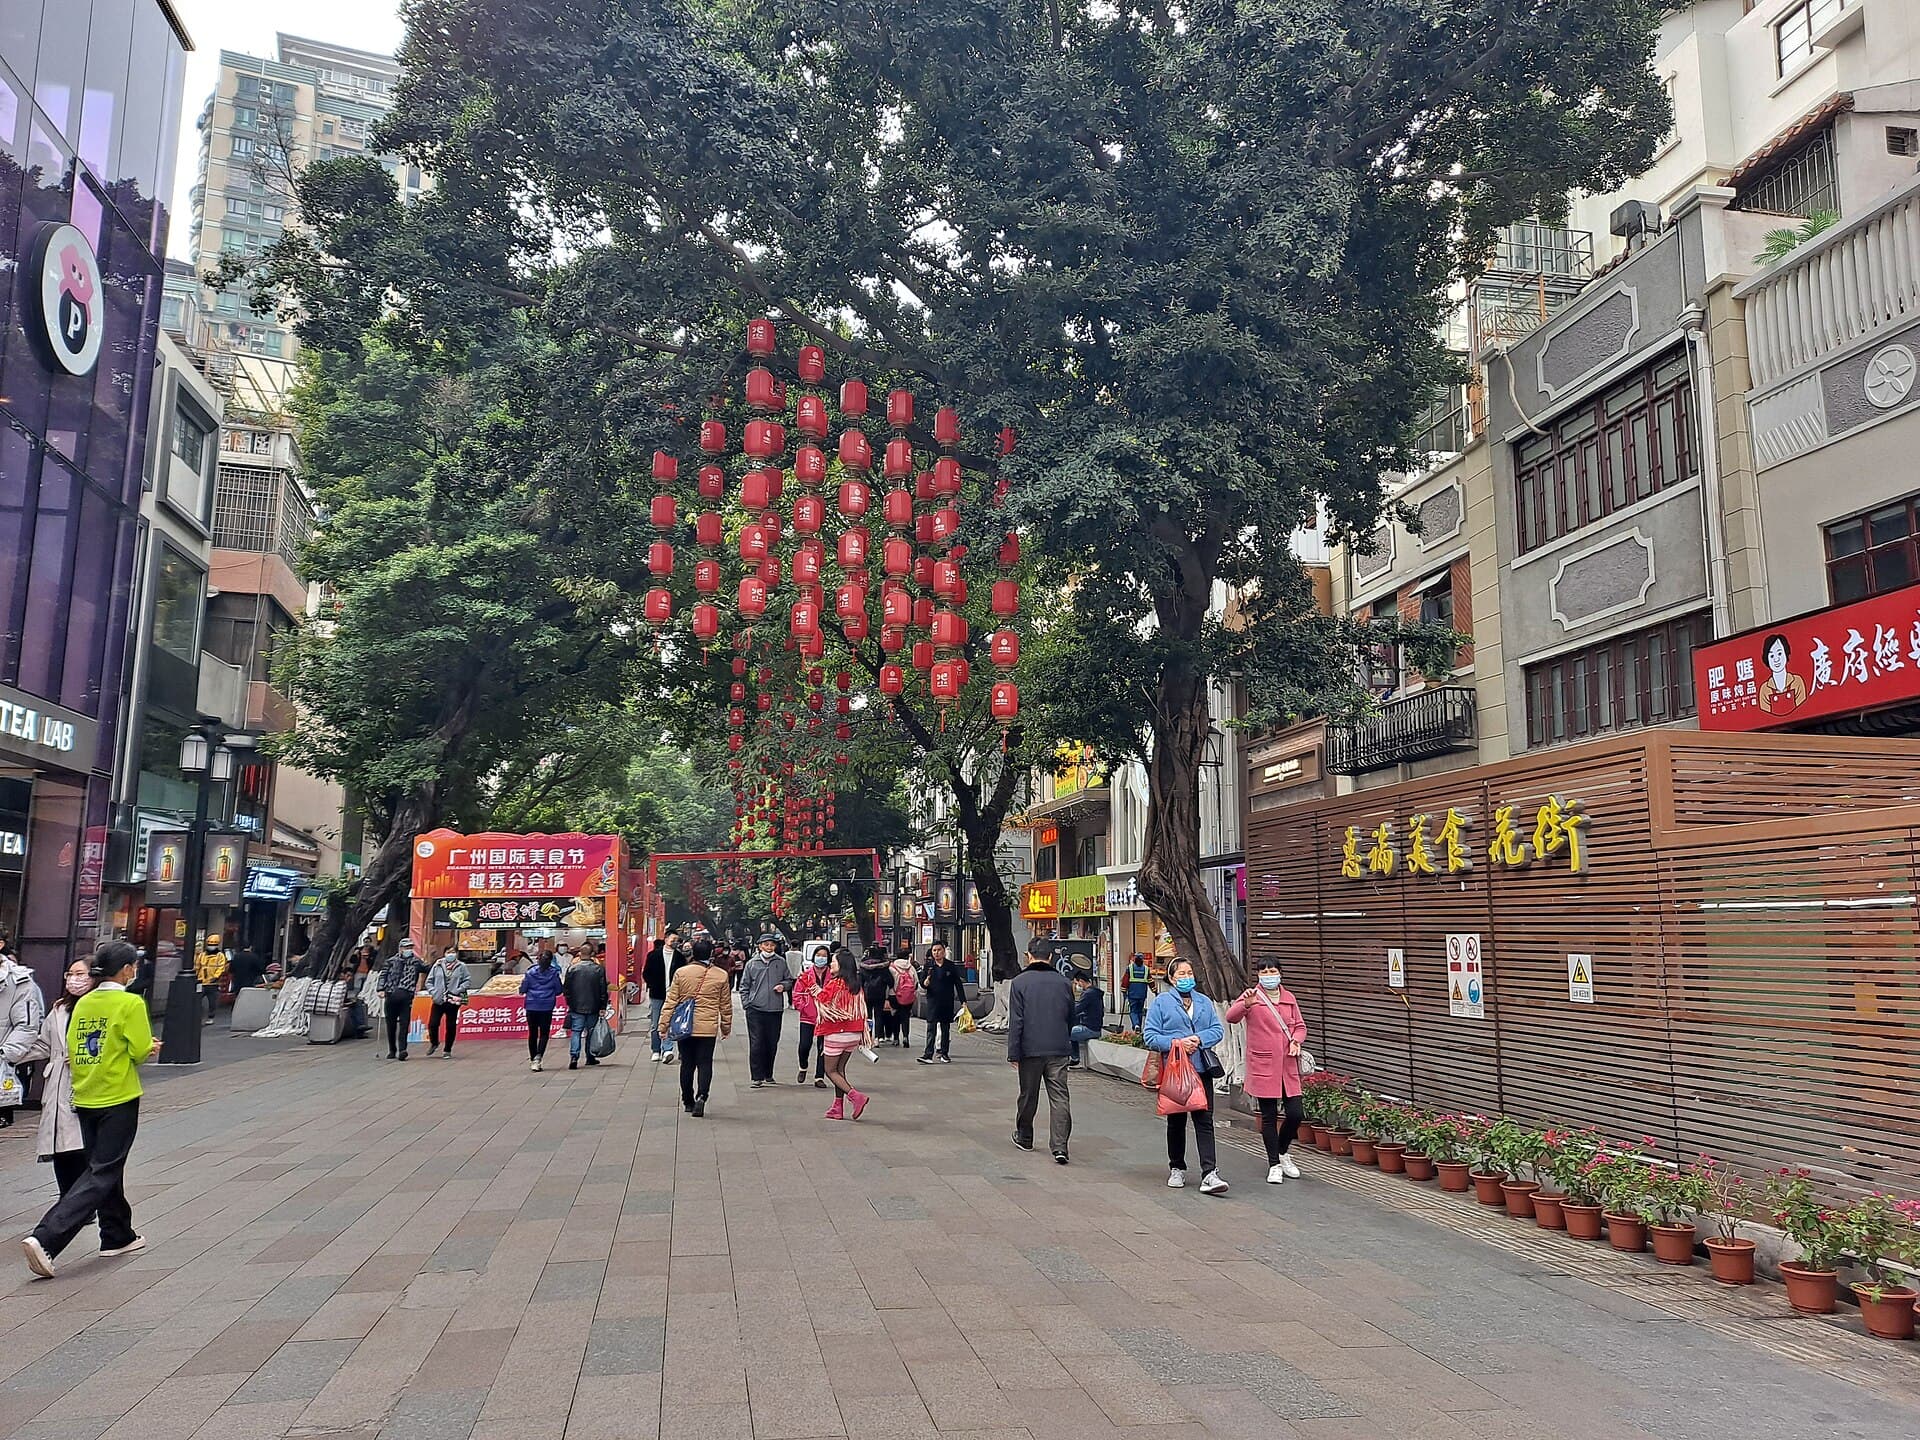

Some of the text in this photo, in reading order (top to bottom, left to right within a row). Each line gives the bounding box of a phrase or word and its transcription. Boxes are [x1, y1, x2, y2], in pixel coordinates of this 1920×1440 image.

[0, 699, 74, 751] TEA LAB
[449, 848, 585, 865] 广州国际美食节
[468, 872, 565, 889] 越秀分会场
[479, 901, 540, 921] 榴莲饼
[456, 1007, 512, 1025] 食越味
